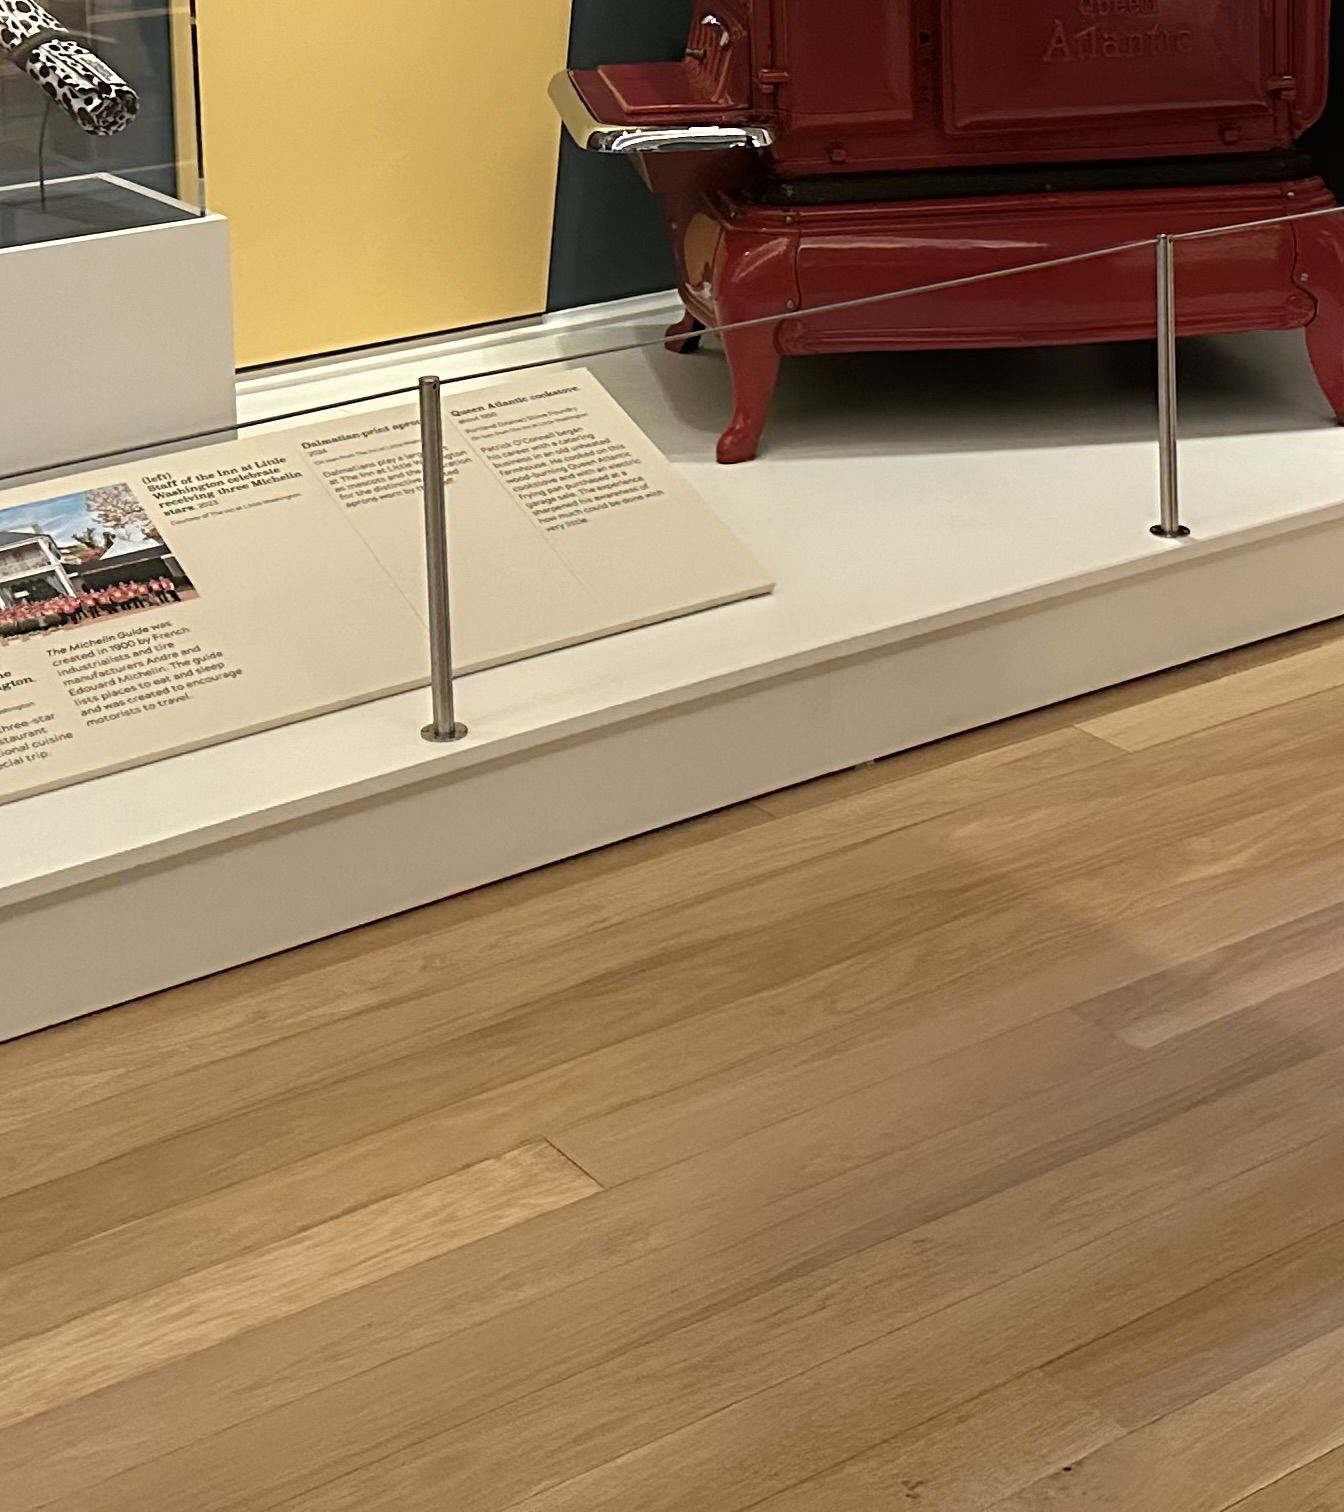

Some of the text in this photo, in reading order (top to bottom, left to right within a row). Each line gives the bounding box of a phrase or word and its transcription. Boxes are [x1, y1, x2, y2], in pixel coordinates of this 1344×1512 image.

[450, 406, 486, 417] Queen
[488, 397, 528, 409] Atlantic
[141, 472, 172, 485] (left)
[147, 457, 286, 492] Staff of the Inn at Little
[152, 468, 280, 500] Washington celebrate
[158, 472, 303, 509] receiving three Michelin
[31, 732, 73, 748] cuisine
